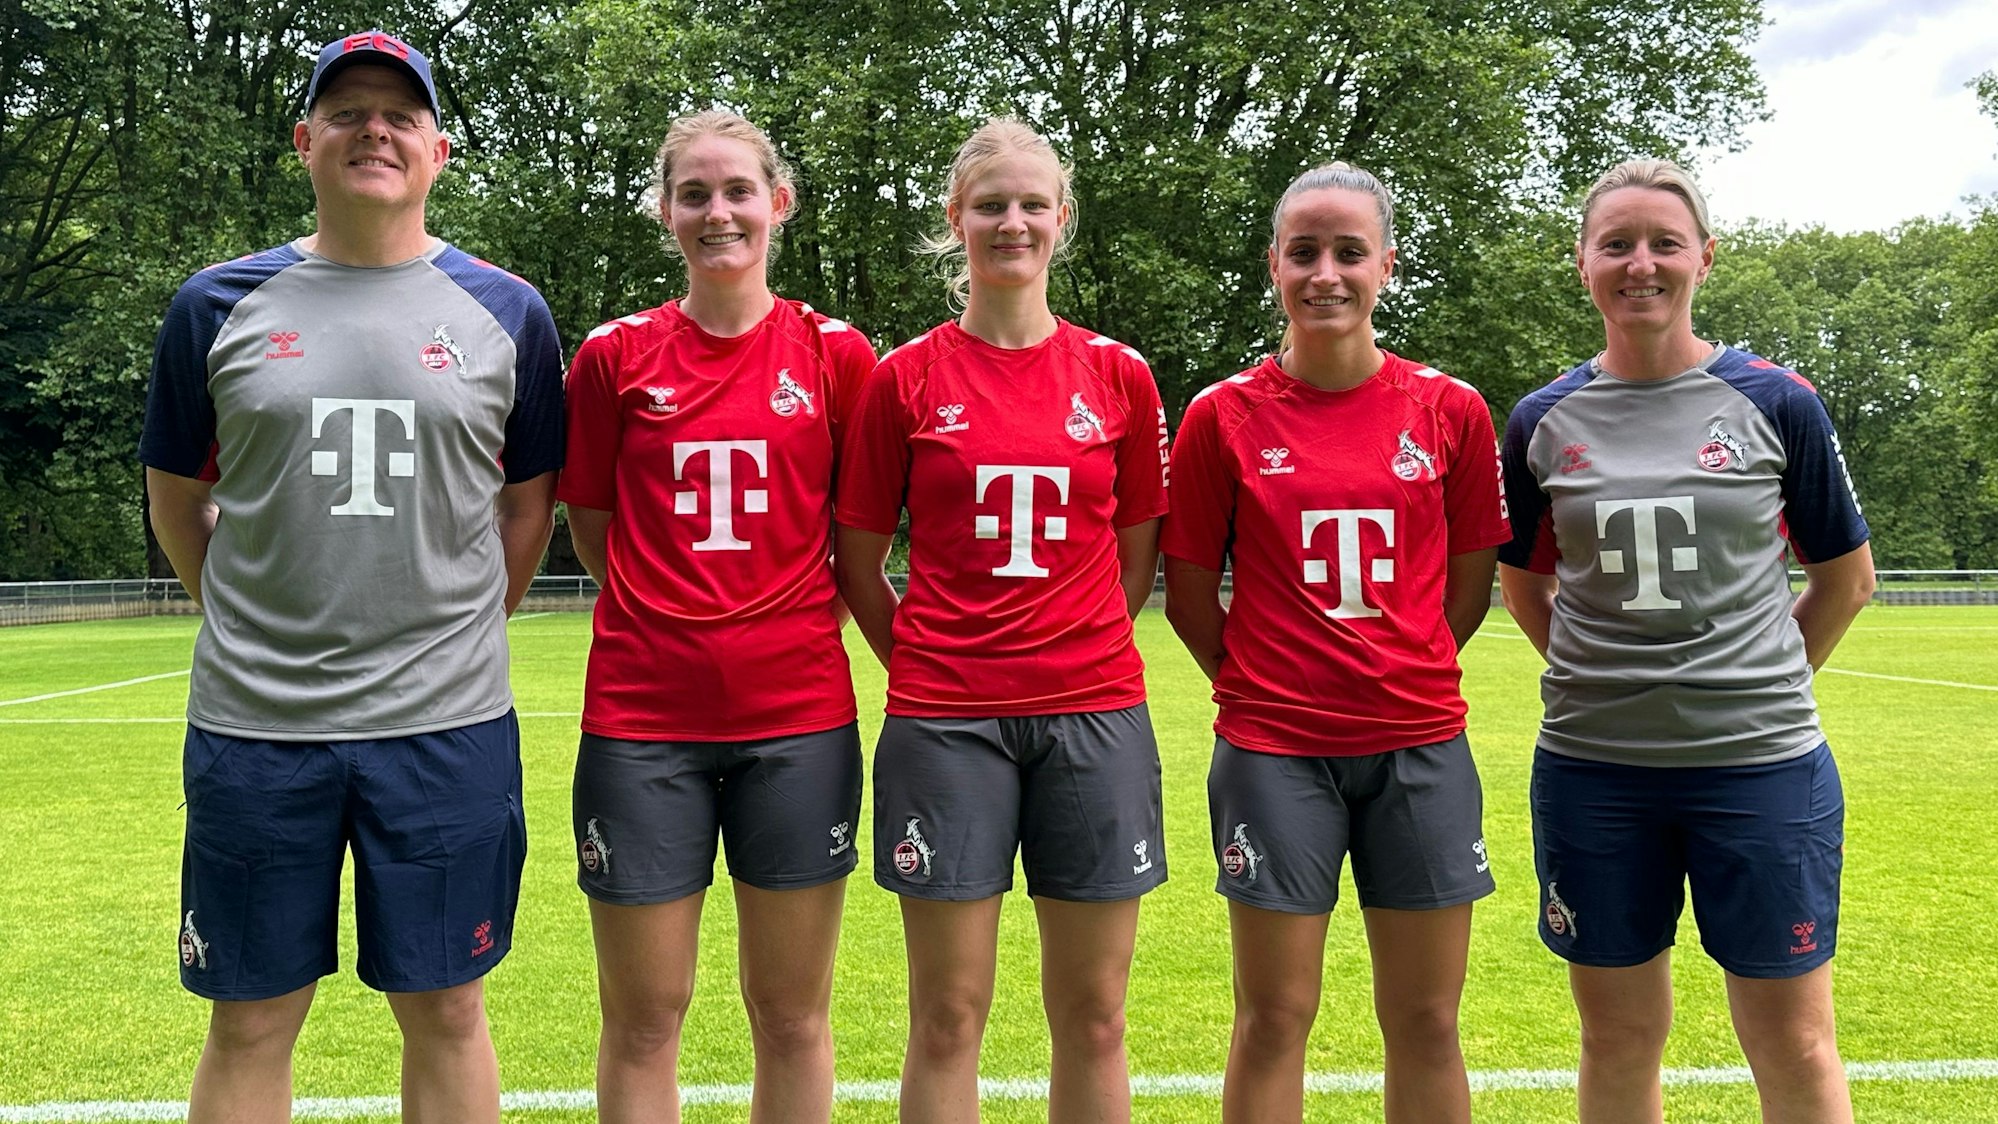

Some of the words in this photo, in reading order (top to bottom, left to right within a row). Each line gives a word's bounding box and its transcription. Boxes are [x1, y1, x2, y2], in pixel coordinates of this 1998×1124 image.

[265, 349, 304, 360] hummel
[311, 397, 415, 516] T
[935, 421, 970, 435] hummel
[1259, 465, 1295, 476] hummel
[672, 439, 768, 551] T
[975, 464, 1070, 578] T
[1301, 508, 1395, 619] T
[1595, 495, 1699, 610] T
